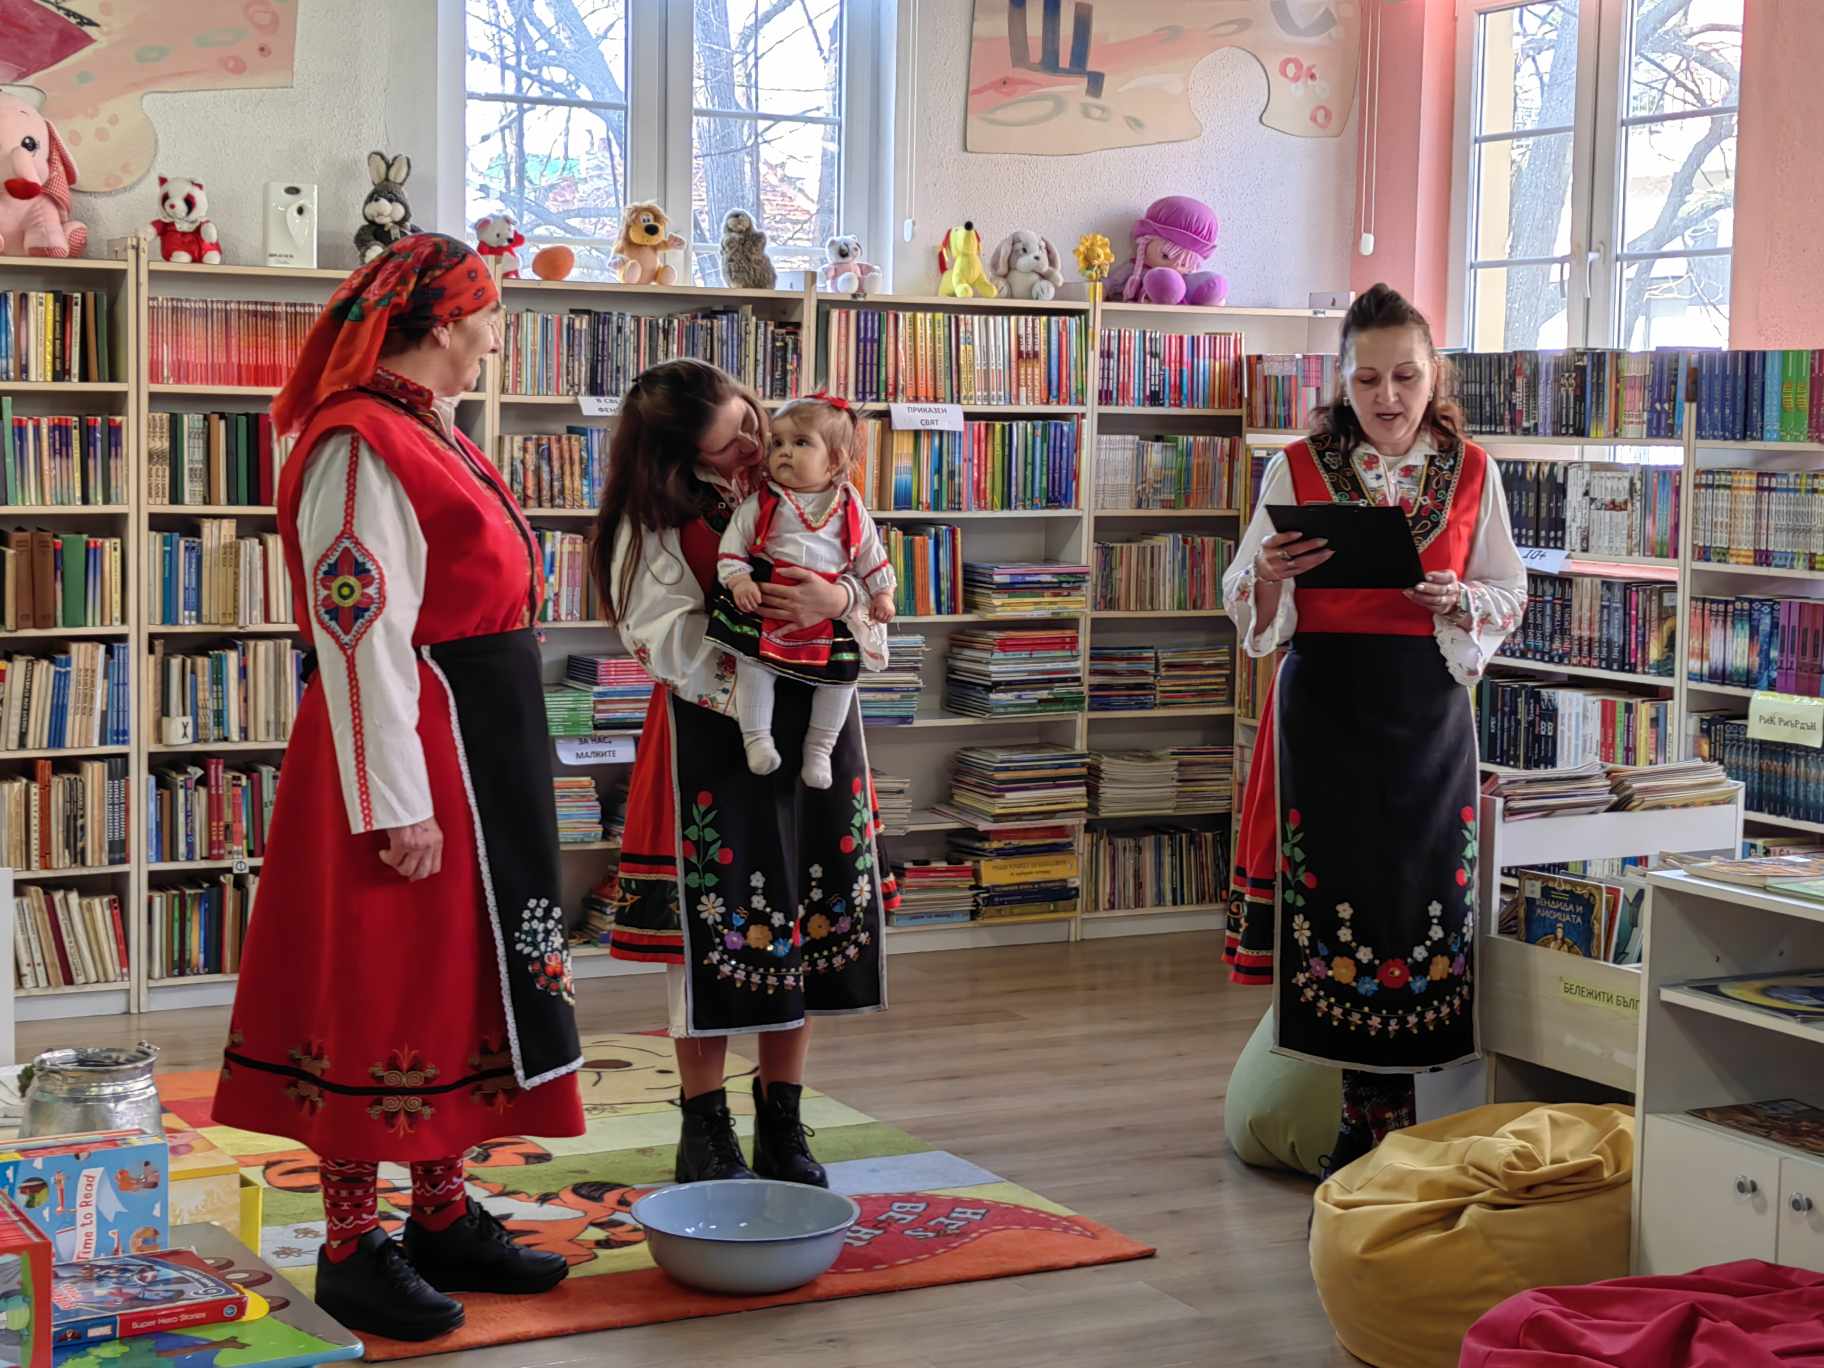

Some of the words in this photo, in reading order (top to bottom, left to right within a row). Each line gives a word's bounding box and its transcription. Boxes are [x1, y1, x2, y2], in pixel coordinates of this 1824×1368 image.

[907, 406, 947, 414] ПРИКАЗЕН
[920, 418, 939, 426] СВЯТ
[576, 750, 617, 760] МАЛКИТЕ
[1563, 982, 1614, 1004] БЕЛЕЖИТИ
[79, 1174, 96, 1208] Read
[80, 1212, 94, 1227] to
[131, 1320, 156, 1329] Super
[157, 1316, 178, 1325] Hero
[179, 1312, 207, 1322] Stories
